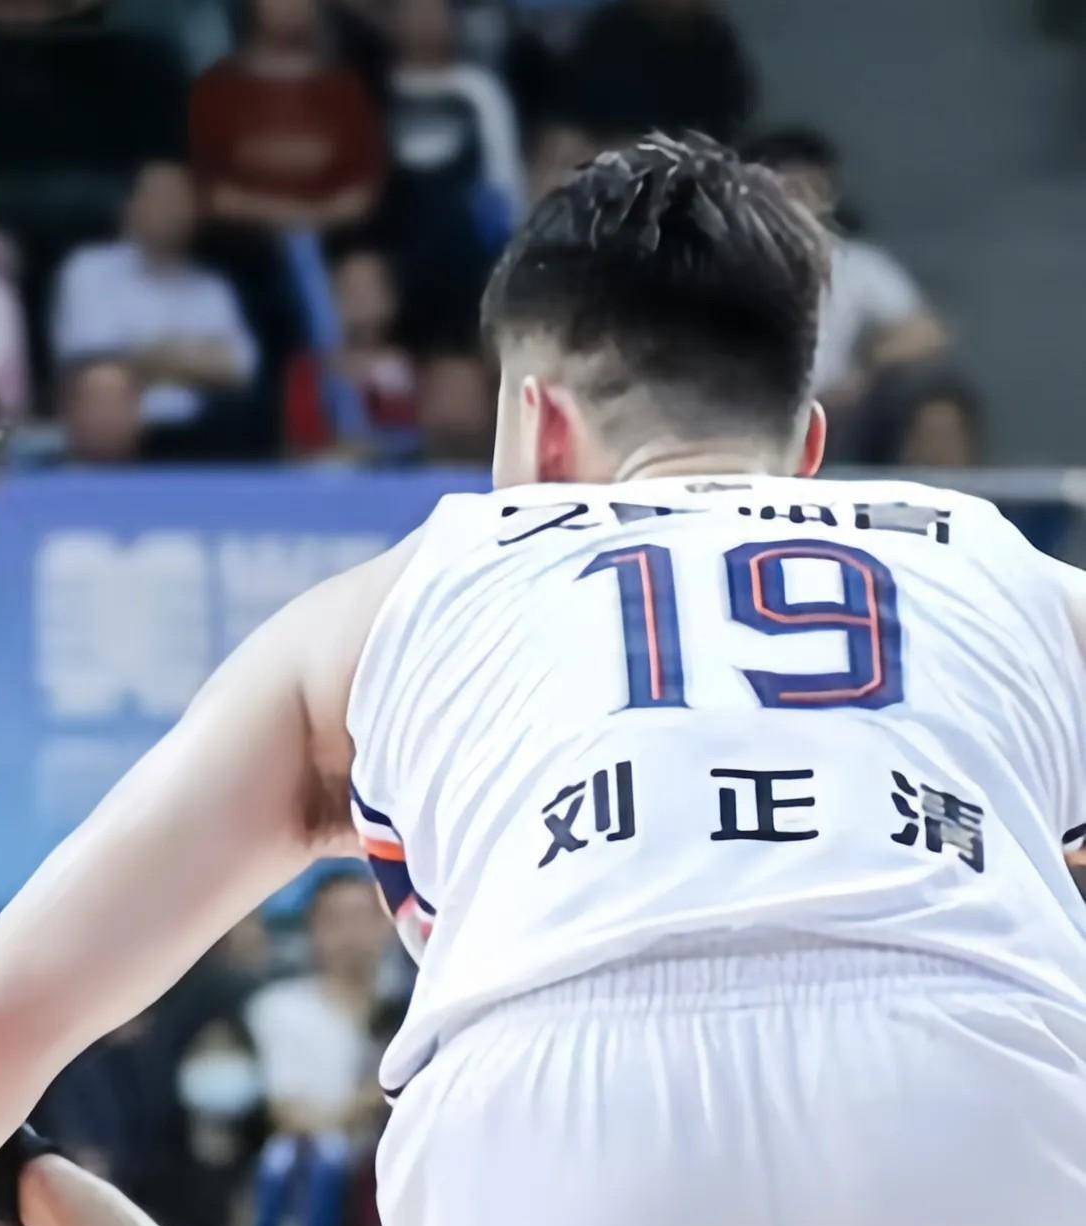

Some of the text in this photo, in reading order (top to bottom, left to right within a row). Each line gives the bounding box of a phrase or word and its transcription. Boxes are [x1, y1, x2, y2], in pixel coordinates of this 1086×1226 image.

[573, 538, 906, 713] 19
[538, 760, 985, 873] 刘正清
